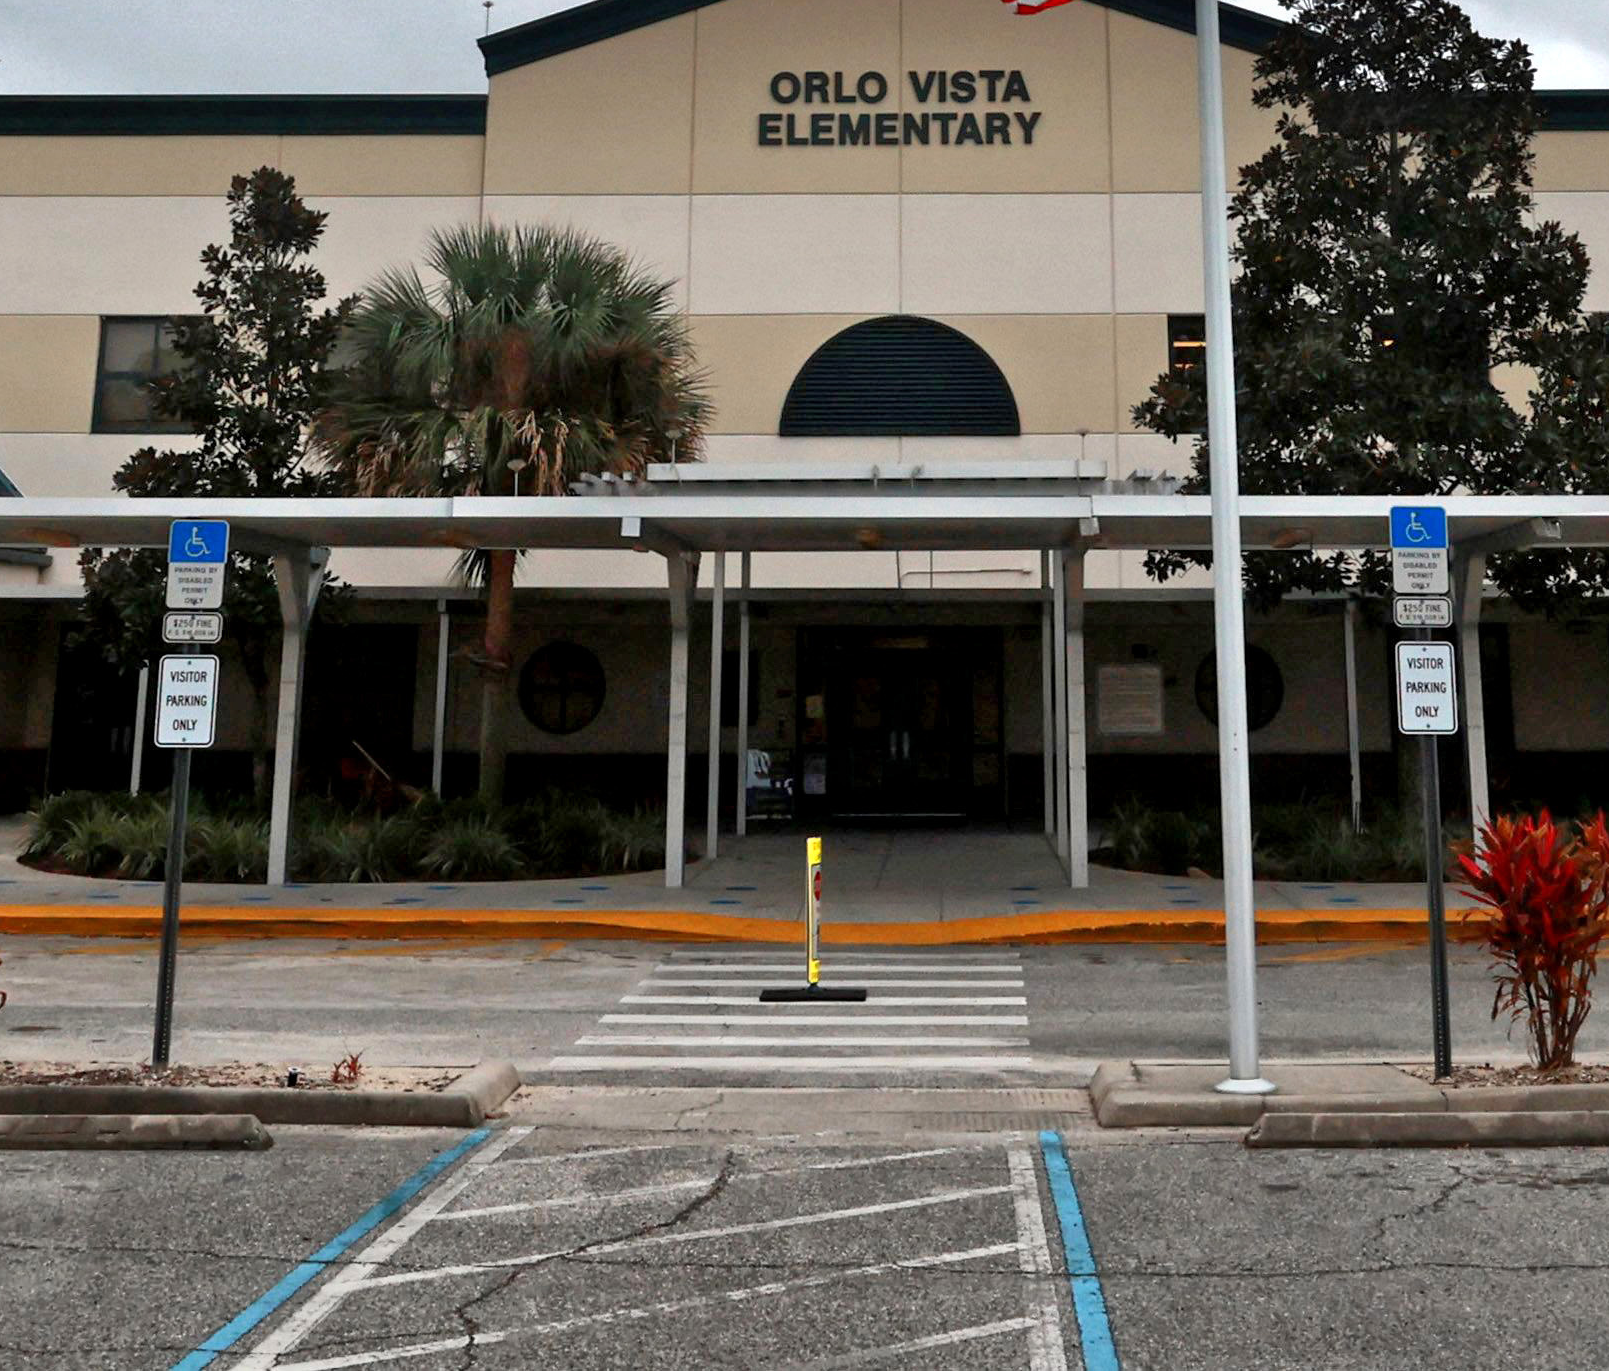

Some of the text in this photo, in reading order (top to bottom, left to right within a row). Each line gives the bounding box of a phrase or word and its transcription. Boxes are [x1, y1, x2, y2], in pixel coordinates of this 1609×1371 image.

[769, 70, 1031, 104] ORLO VISTA
[758, 111, 1042, 146] ELEMENTARY
[1403, 603, 1442, 613] $250 FINE
[173, 618, 195, 628] $250
[1407, 657, 1444, 669] VISITOR
[170, 671, 208, 683] VISITOR
[1406, 681, 1447, 693] PARKING
[166, 695, 208, 707] PARKING
[1415, 705, 1439, 717] ONLY
[172, 719, 198, 731] ONLY
